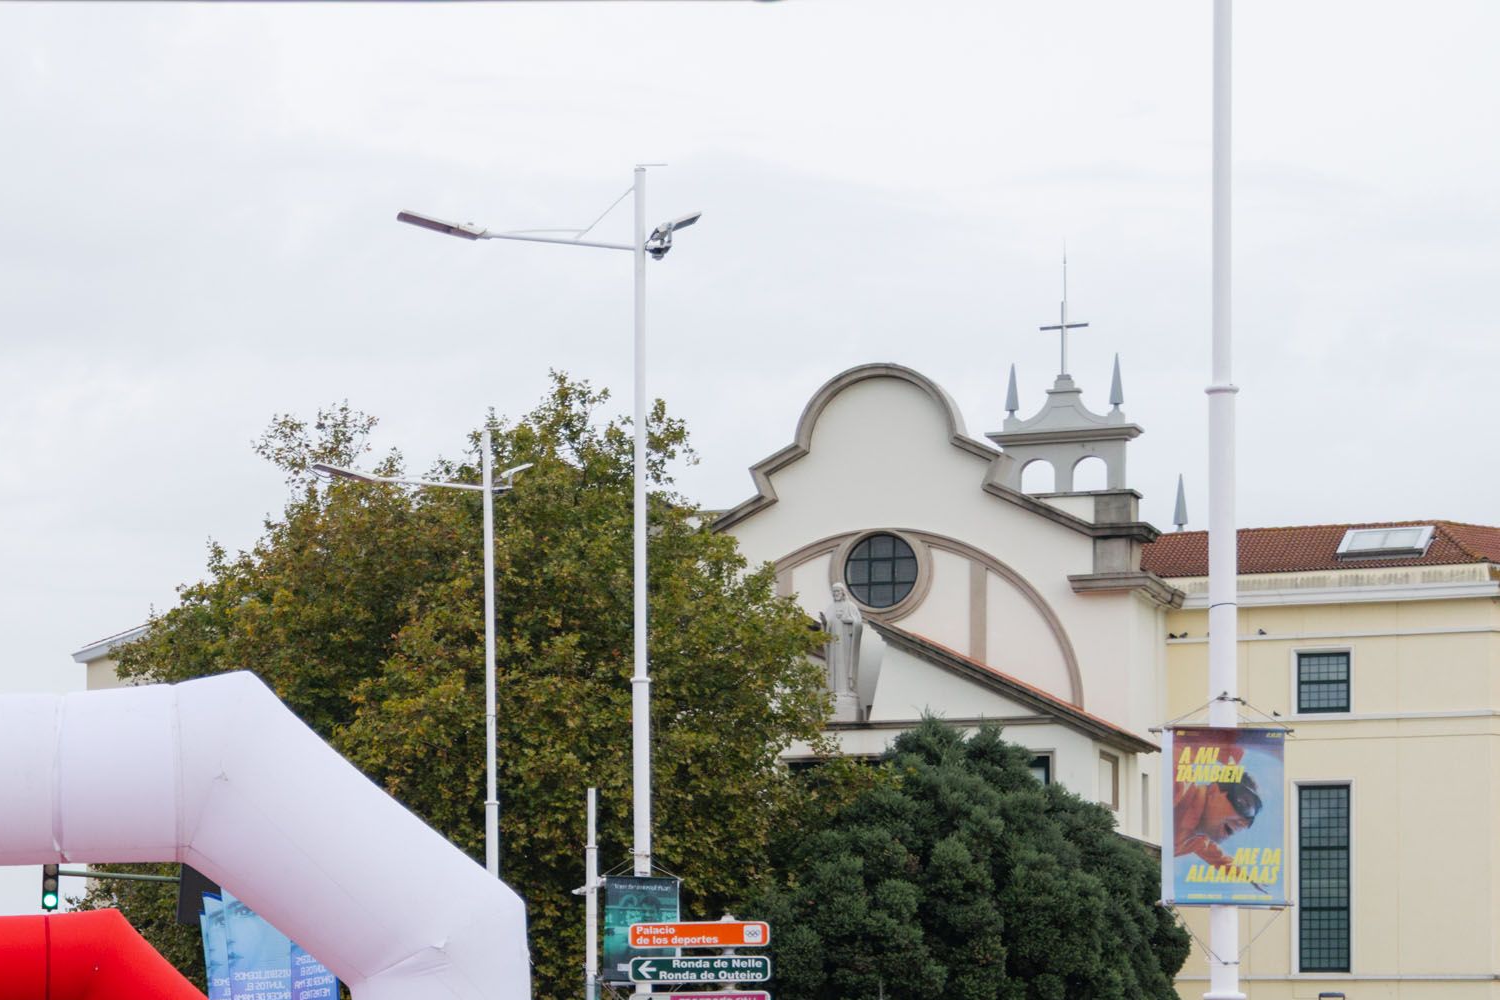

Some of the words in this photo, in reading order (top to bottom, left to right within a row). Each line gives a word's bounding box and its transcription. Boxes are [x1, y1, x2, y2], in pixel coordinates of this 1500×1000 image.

[1179, 746, 1191, 765] A
[1234, 848, 1259, 865] ME
[1261, 848, 1282, 866] DA
[636, 926, 676, 935] Palacio
[636, 937, 649, 945] de
[653, 936, 668, 945] los
[672, 936, 719, 946] deportes
[672, 959, 711, 968] Ronda
[713, 959, 728, 968] de
[731, 959, 763, 968] Nelle
[659, 971, 697, 980] Ronda
[700, 971, 715, 980] de
[718, 971, 763, 980] Outeiro
